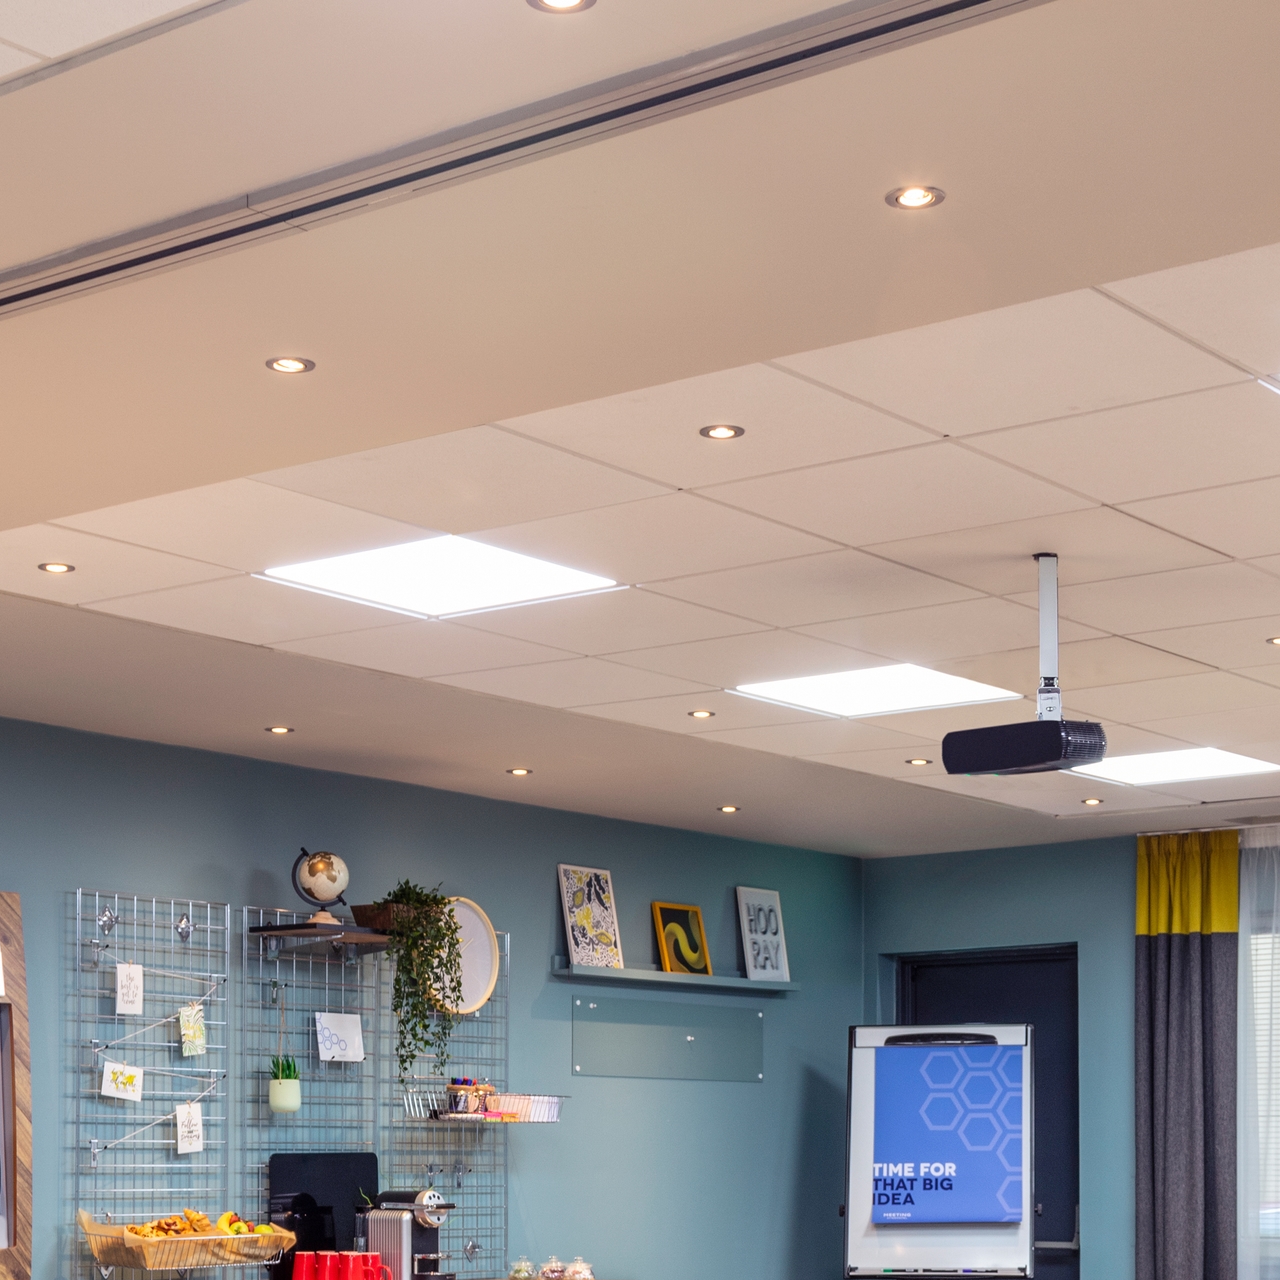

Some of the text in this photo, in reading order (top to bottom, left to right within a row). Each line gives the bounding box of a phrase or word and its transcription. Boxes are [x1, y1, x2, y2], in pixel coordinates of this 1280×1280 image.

[873, 1162, 956, 1177] TIME FOR
[873, 1178, 953, 1191] THAT BIG
[872, 1193, 915, 1205] IDEA
